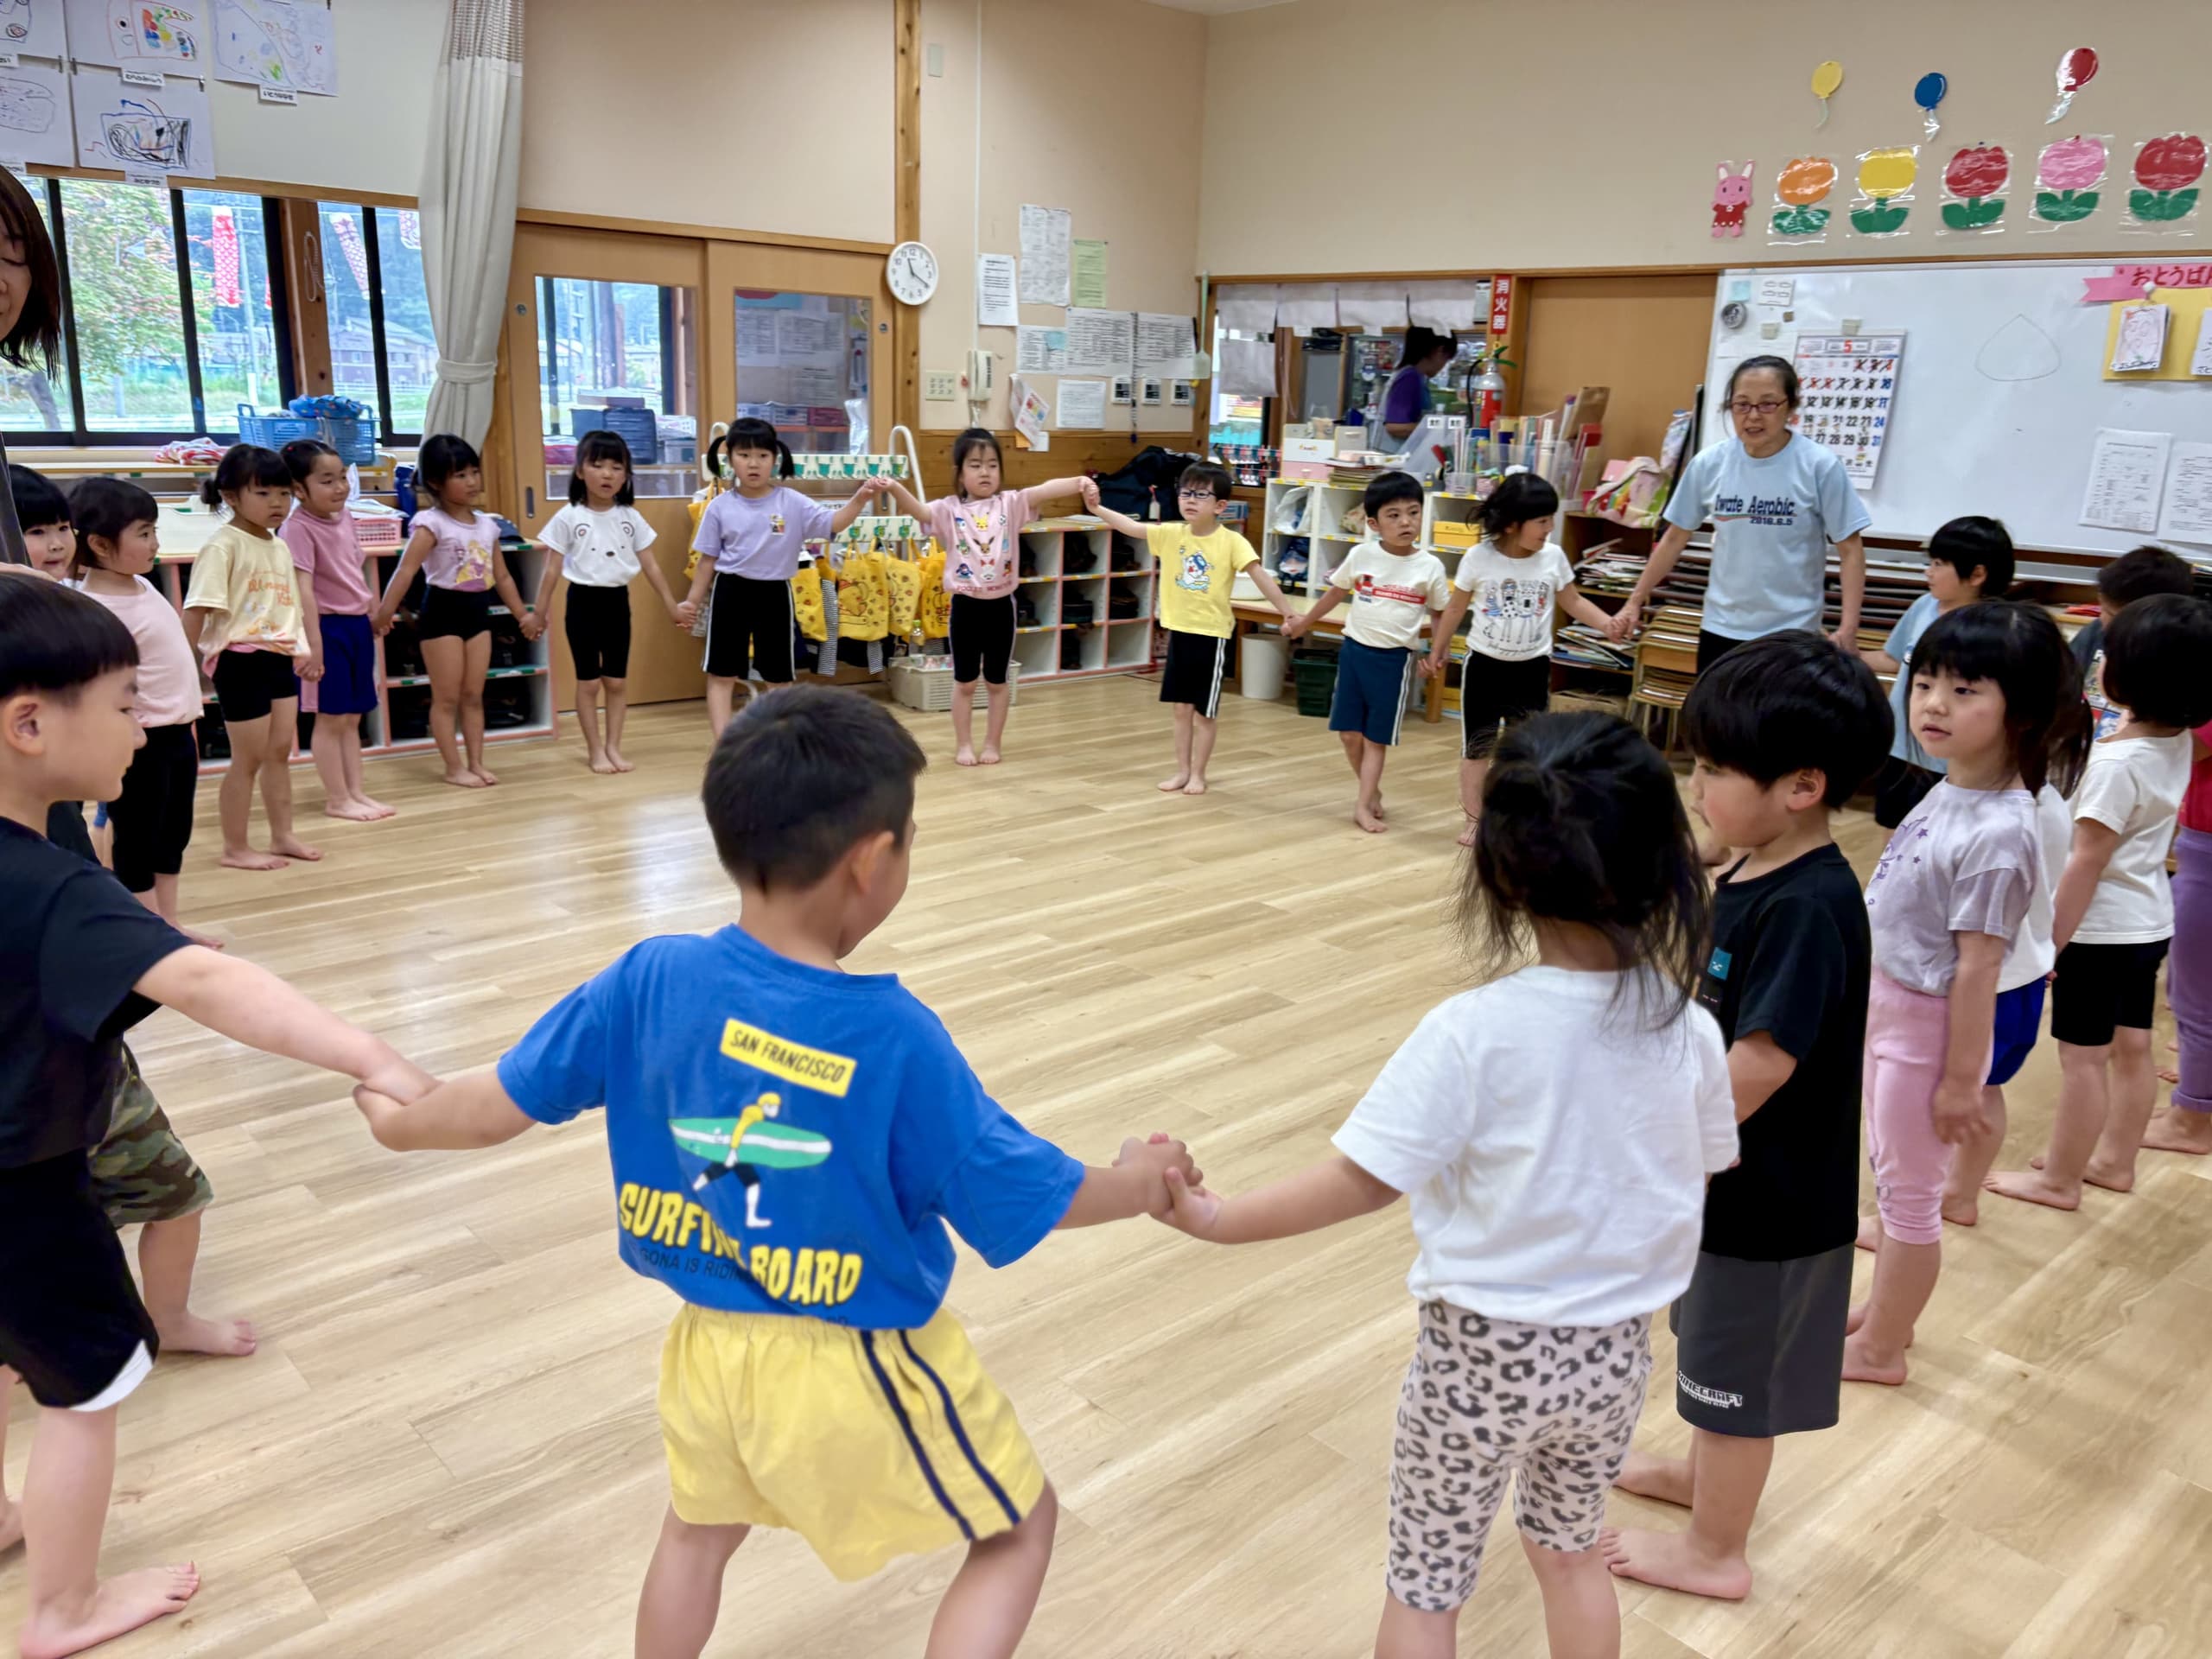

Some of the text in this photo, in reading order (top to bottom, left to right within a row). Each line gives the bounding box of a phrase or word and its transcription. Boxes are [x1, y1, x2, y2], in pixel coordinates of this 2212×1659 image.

[1492, 279, 1510, 329] 消火器
[1843, 339, 1853, 353] 5
[1846, 416, 1858, 427] 22
[1873, 416, 1885, 428] 24
[1828, 434, 1840, 444] 28
[1843, 434, 1855, 445] 29
[1714, 494, 1796, 516] Iwate Aerobic
[730, 1029, 846, 1084] SAN FRANCISCO
[750, 1244, 863, 1306] BOARD
